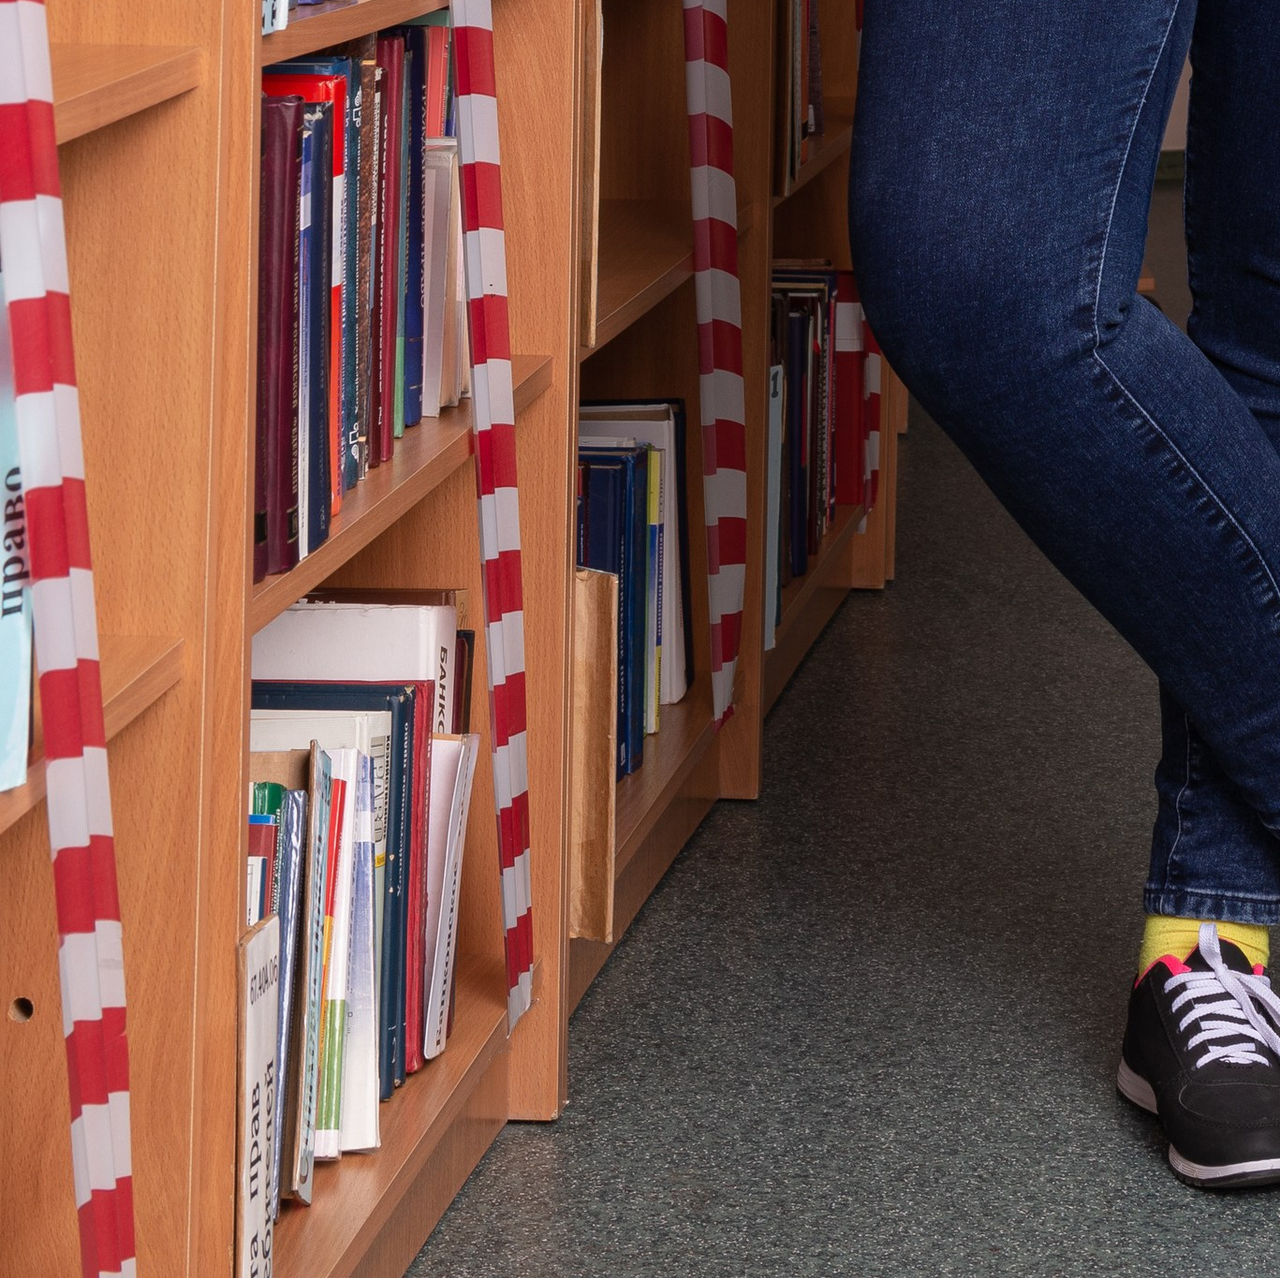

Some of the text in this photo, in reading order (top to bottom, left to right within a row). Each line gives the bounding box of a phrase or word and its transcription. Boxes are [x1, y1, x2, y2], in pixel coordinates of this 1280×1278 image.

[1, 466, 30, 620] право
[383, 735, 391, 841] ХОЗЯЙСТВЕННОЕ
[250, 955, 279, 1005] 67.404.06
[249, 1081, 262, 1202] прав
